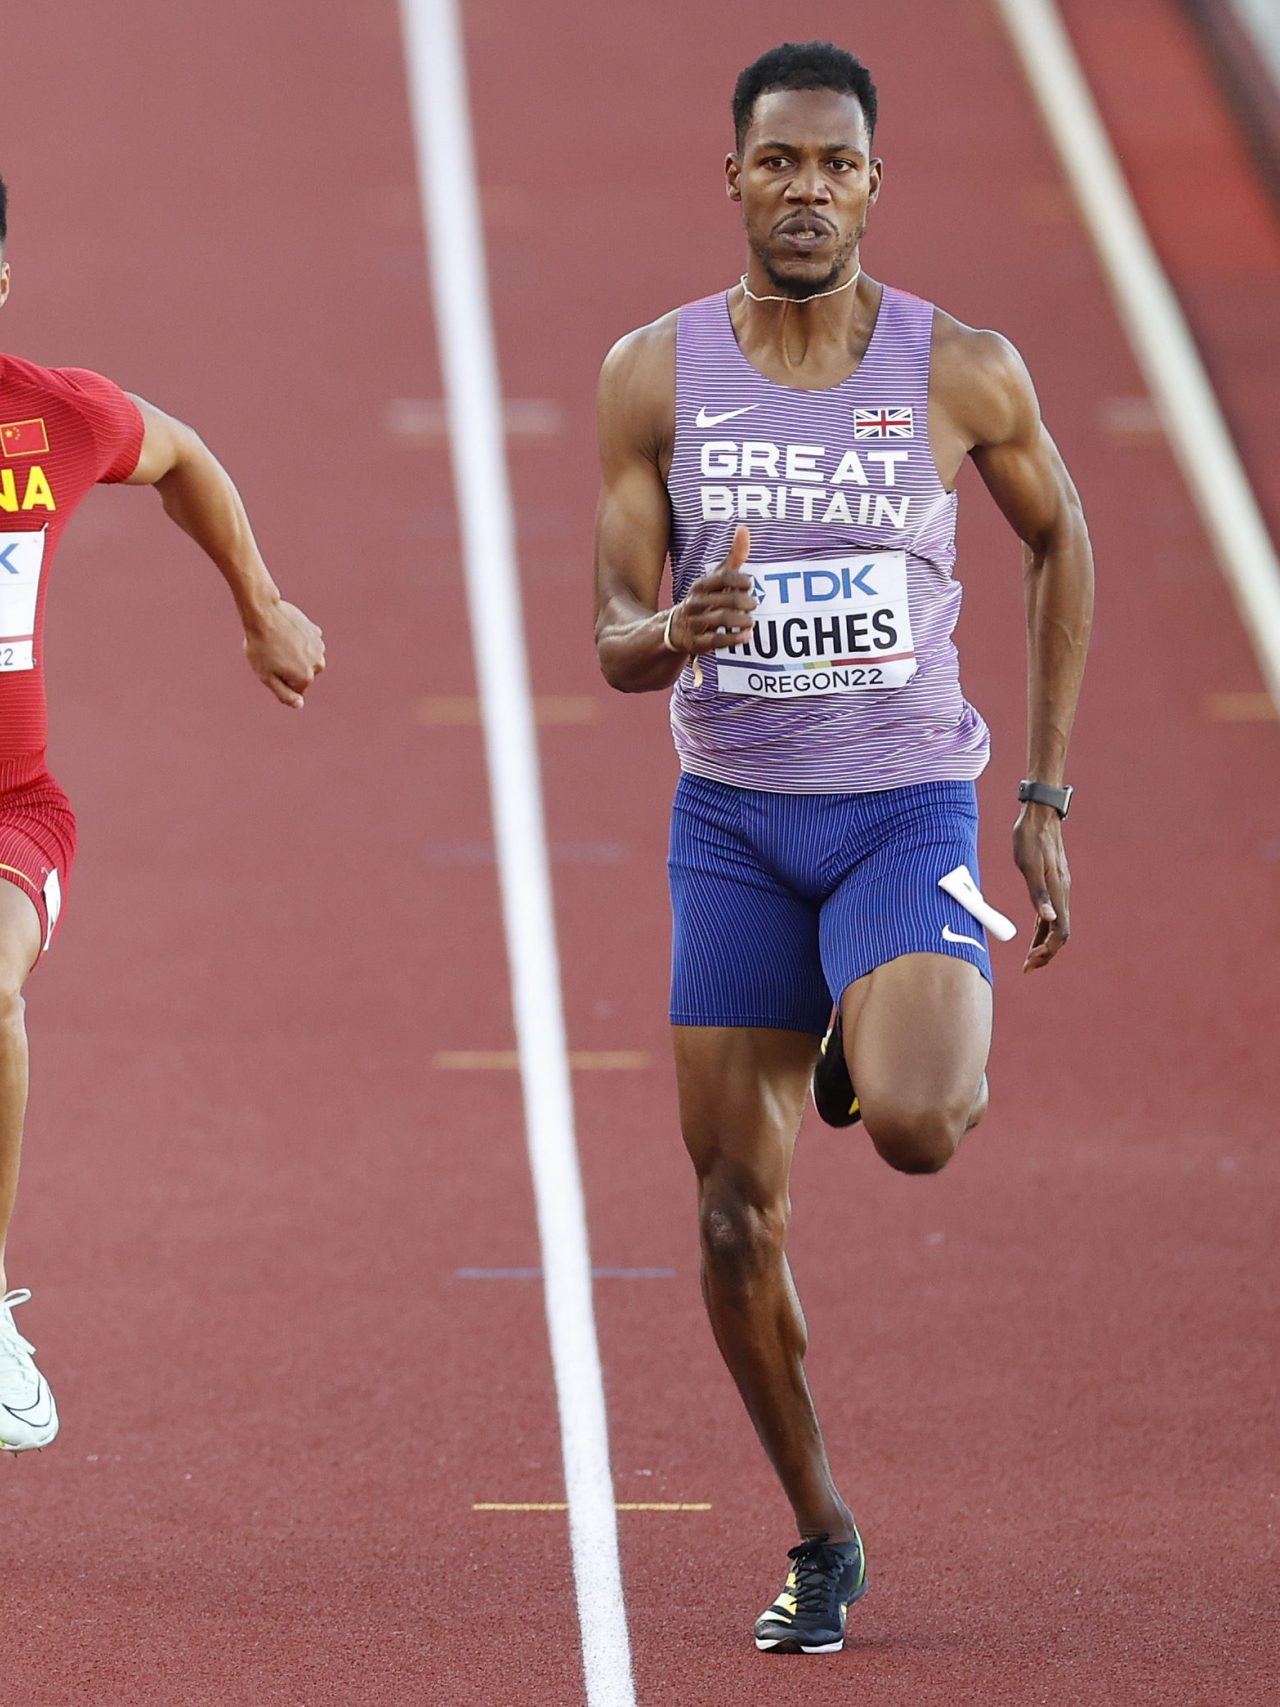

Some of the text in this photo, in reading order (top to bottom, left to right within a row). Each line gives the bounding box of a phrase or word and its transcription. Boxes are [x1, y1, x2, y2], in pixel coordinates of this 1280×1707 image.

[700, 440, 909, 487] GREAT
[700, 485, 911, 529] BRITAIN
[764, 563, 879, 604] TDK
[747, 668, 884, 694] OREGON22
